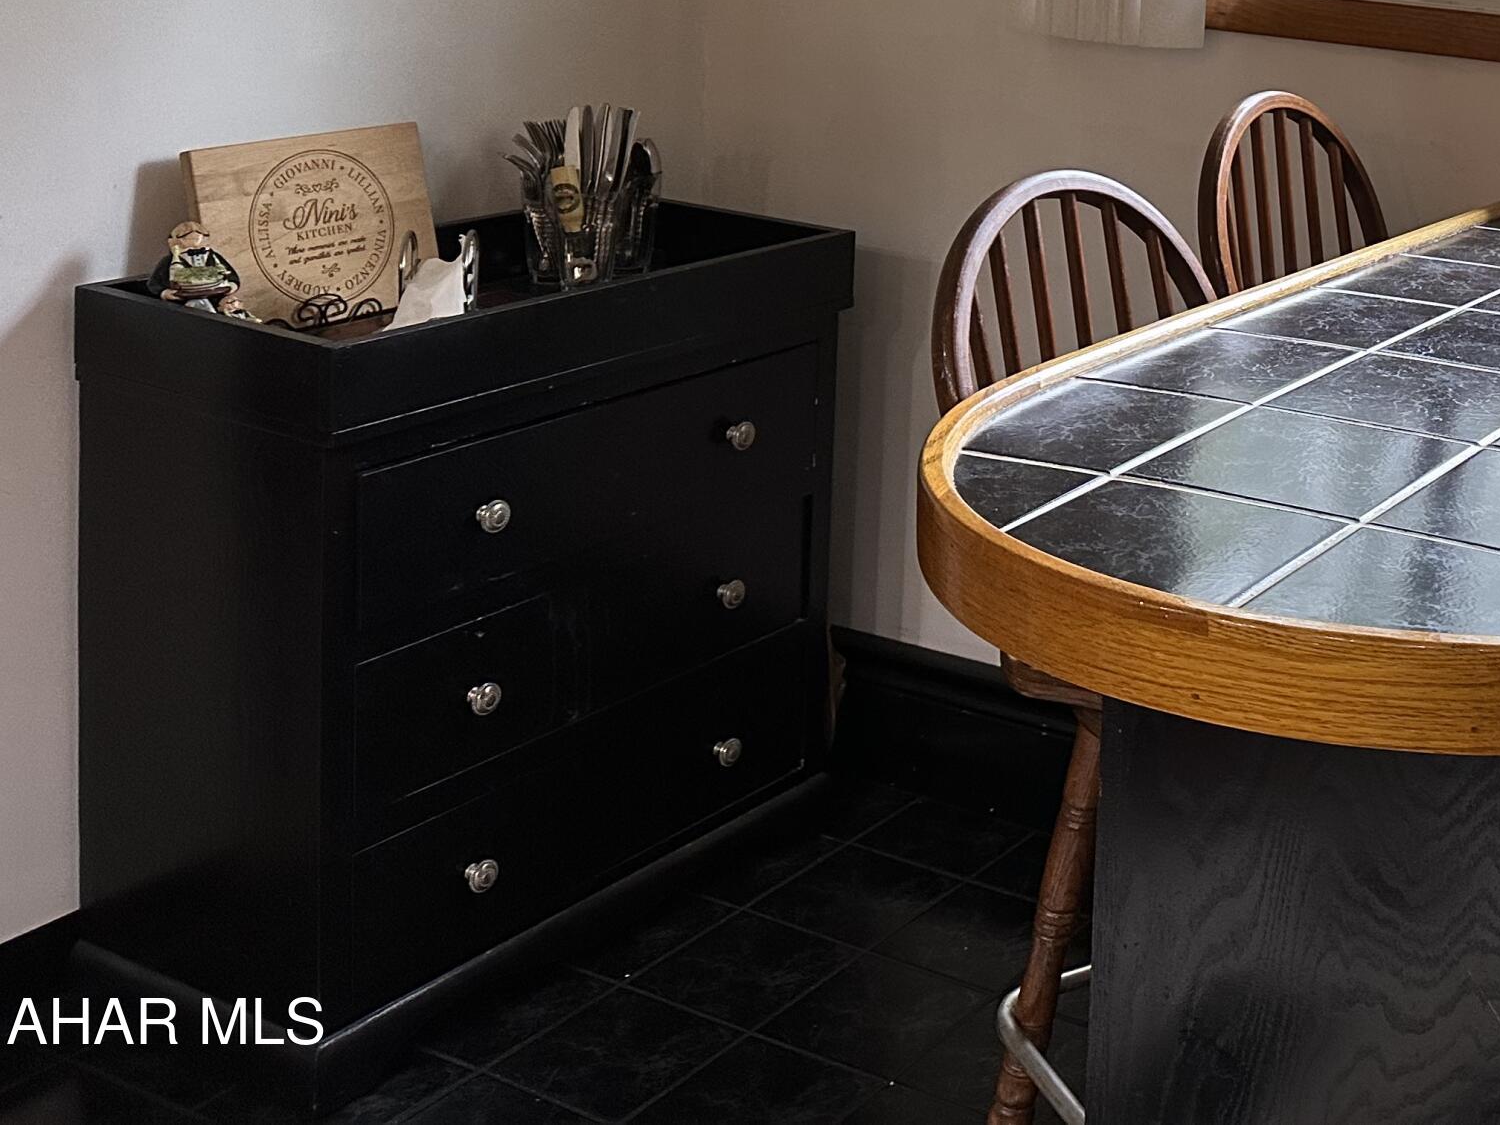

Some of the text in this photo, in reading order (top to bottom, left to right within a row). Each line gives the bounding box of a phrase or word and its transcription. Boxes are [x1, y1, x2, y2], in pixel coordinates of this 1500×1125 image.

[273, 158, 335, 189] GIOVANNI
[347, 167, 384, 214] LILLIAN
[258, 202, 276, 258] ALLISSA
[283, 197, 359, 230] Nini's
[296, 223, 352, 241] KITCHEN
[345, 229, 387, 290] VINCENZO
[277, 269, 331, 295] AUDREY
